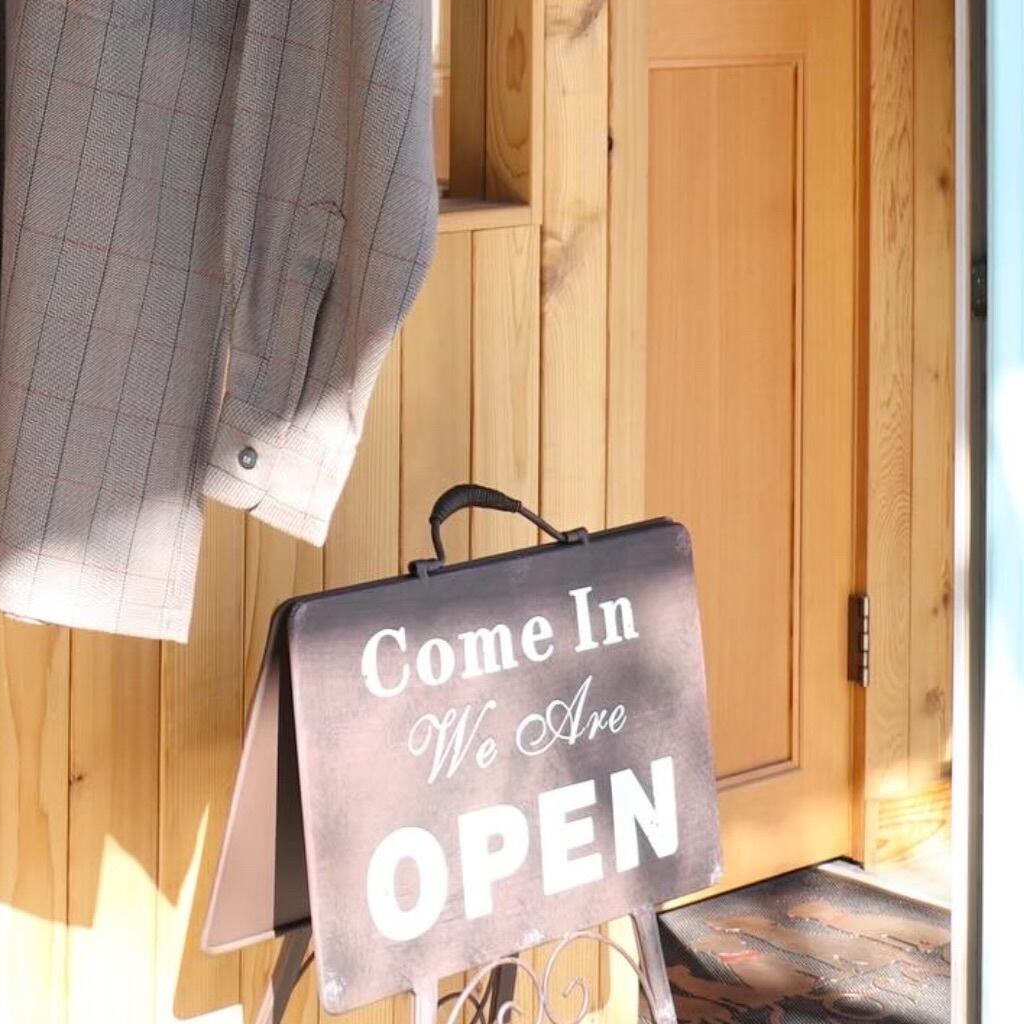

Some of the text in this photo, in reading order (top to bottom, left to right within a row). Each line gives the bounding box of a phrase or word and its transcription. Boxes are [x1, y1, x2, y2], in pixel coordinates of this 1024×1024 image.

[361, 586, 639, 698] Come In
[408, 675, 627, 784] We Are
[367, 756, 678, 941] OPEN
